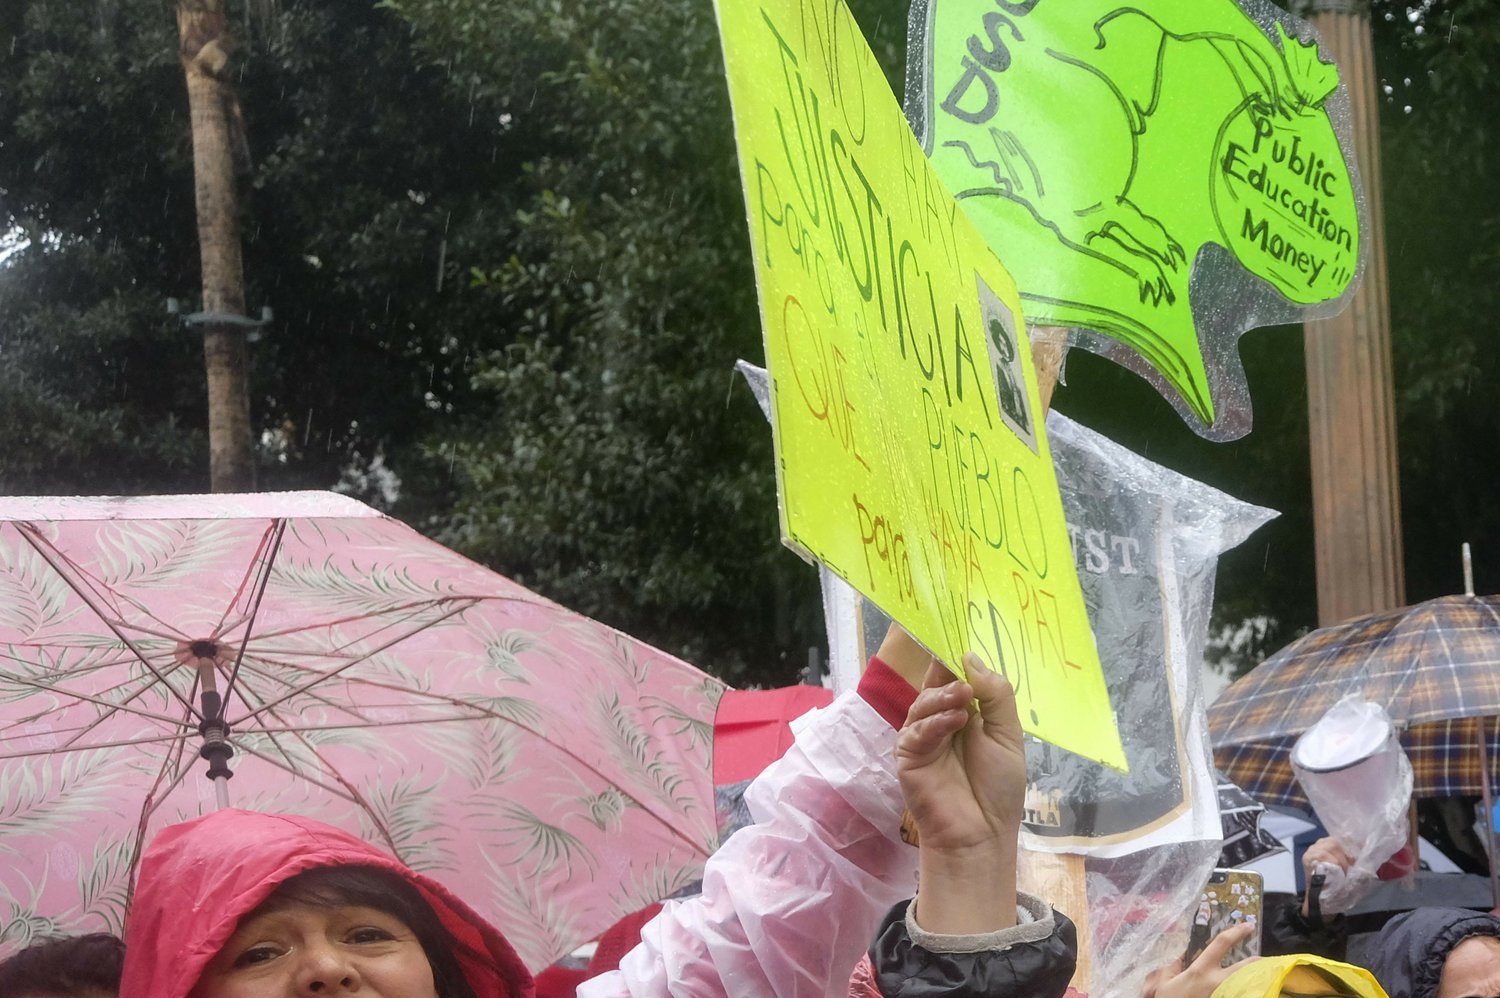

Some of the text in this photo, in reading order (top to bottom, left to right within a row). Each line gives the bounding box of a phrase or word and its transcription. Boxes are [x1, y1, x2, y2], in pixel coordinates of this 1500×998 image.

[1222, 141, 1352, 252] Education
[1252, 117, 1337, 198] Public
[759, 7, 992, 430] JUSTICIA
[1240, 207, 1328, 288] Money
[921, 387, 1049, 580] PUEBLO
[1012, 569, 1082, 678] PAZ
